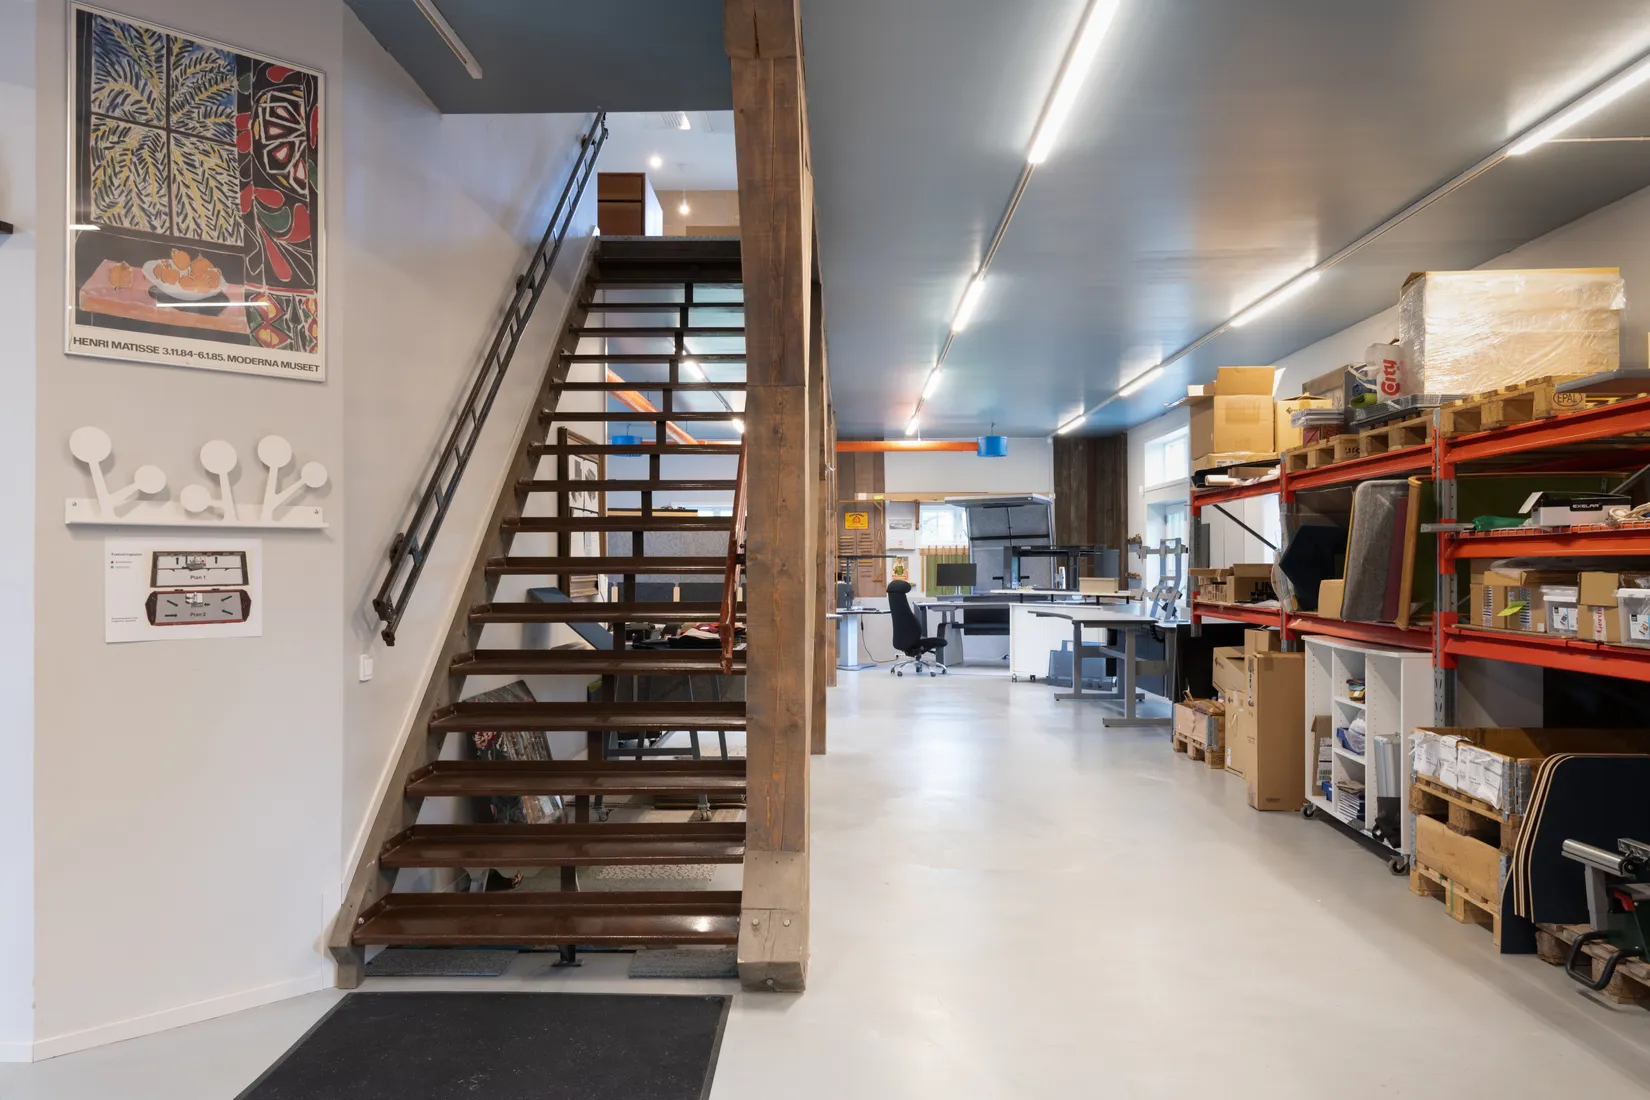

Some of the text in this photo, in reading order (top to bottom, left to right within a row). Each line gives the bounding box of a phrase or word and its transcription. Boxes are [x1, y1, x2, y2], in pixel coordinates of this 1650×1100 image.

[73, 336, 109, 349] HENRI
[111, 341, 160, 355] MATISSE
[226, 354, 279, 368] MODERNA
[280, 360, 321, 373] MUSEET
[1381, 359, 1400, 396] City
[1556, 391, 1578, 403] EPAL
